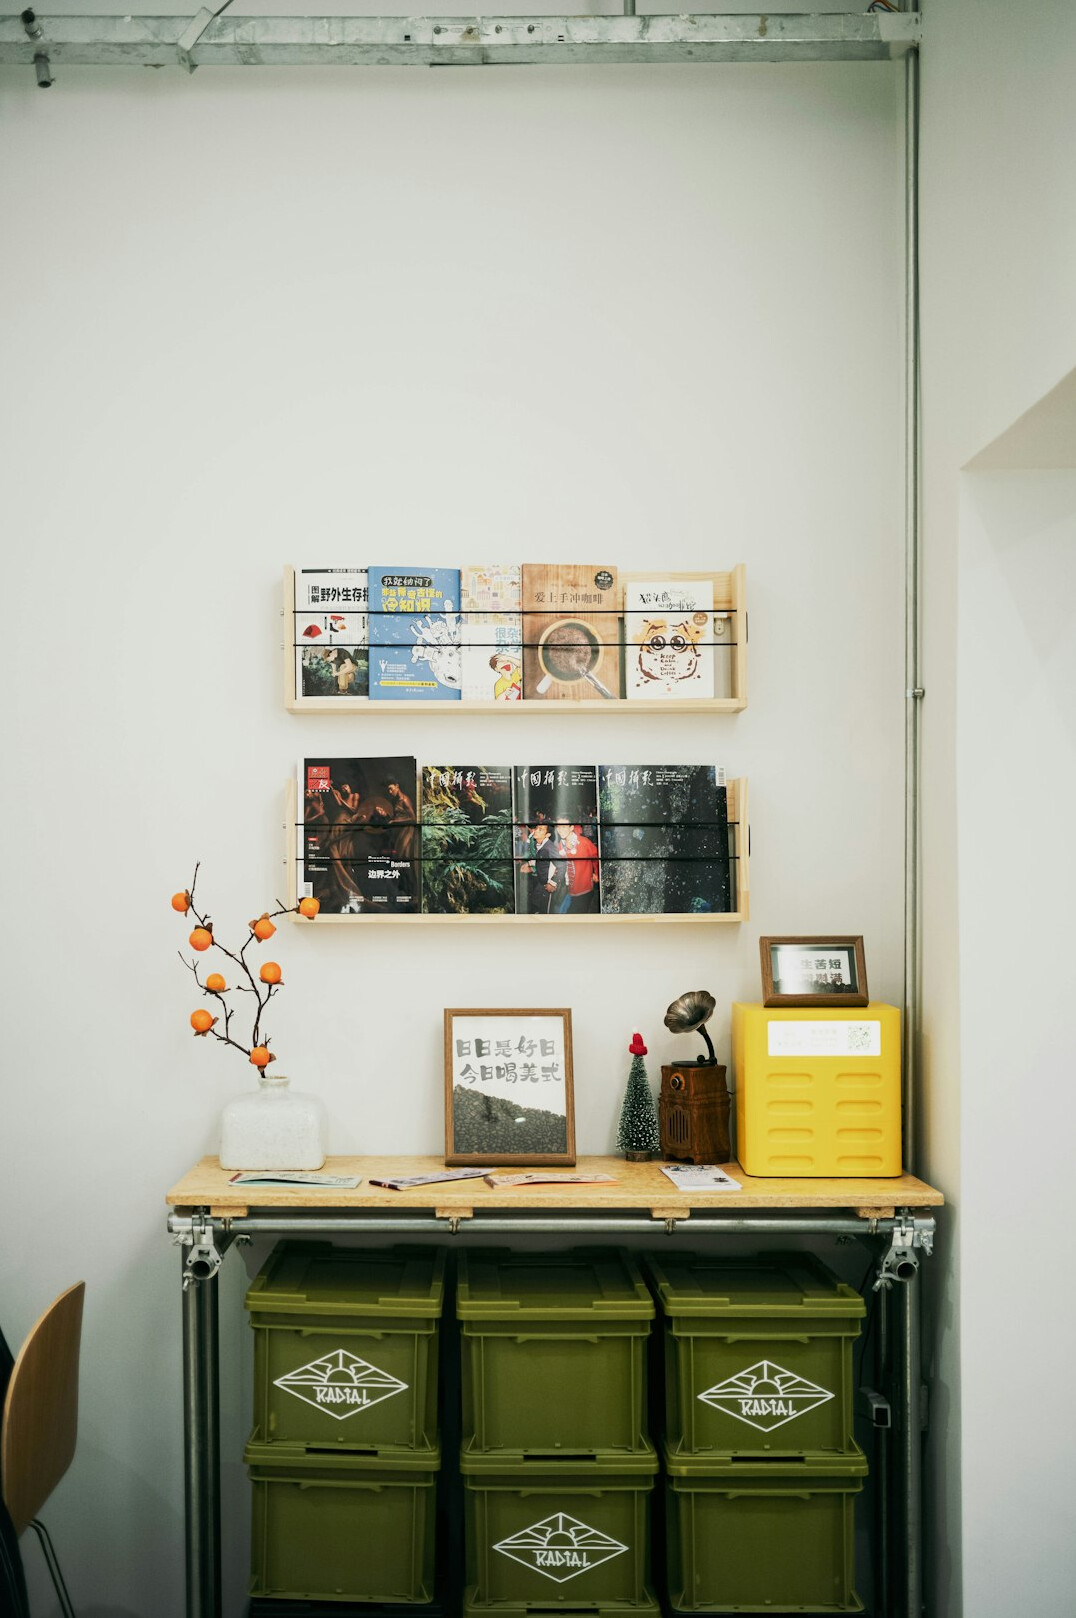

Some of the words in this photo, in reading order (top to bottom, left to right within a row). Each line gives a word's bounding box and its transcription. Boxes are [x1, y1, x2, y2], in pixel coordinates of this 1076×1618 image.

[311, 586, 320, 603] 图解
[534, 592, 603, 604] 爱上手冲咖啡
[368, 870, 400, 879] 边界之外
[456, 1035, 555, 1058] 日日是好日
[460, 1061, 562, 1084] 今日喝美式
[312, 1386, 371, 1405] RADIAL
[737, 1399, 797, 1416] RADIAL
[532, 1550, 591, 1567] RADIAL
